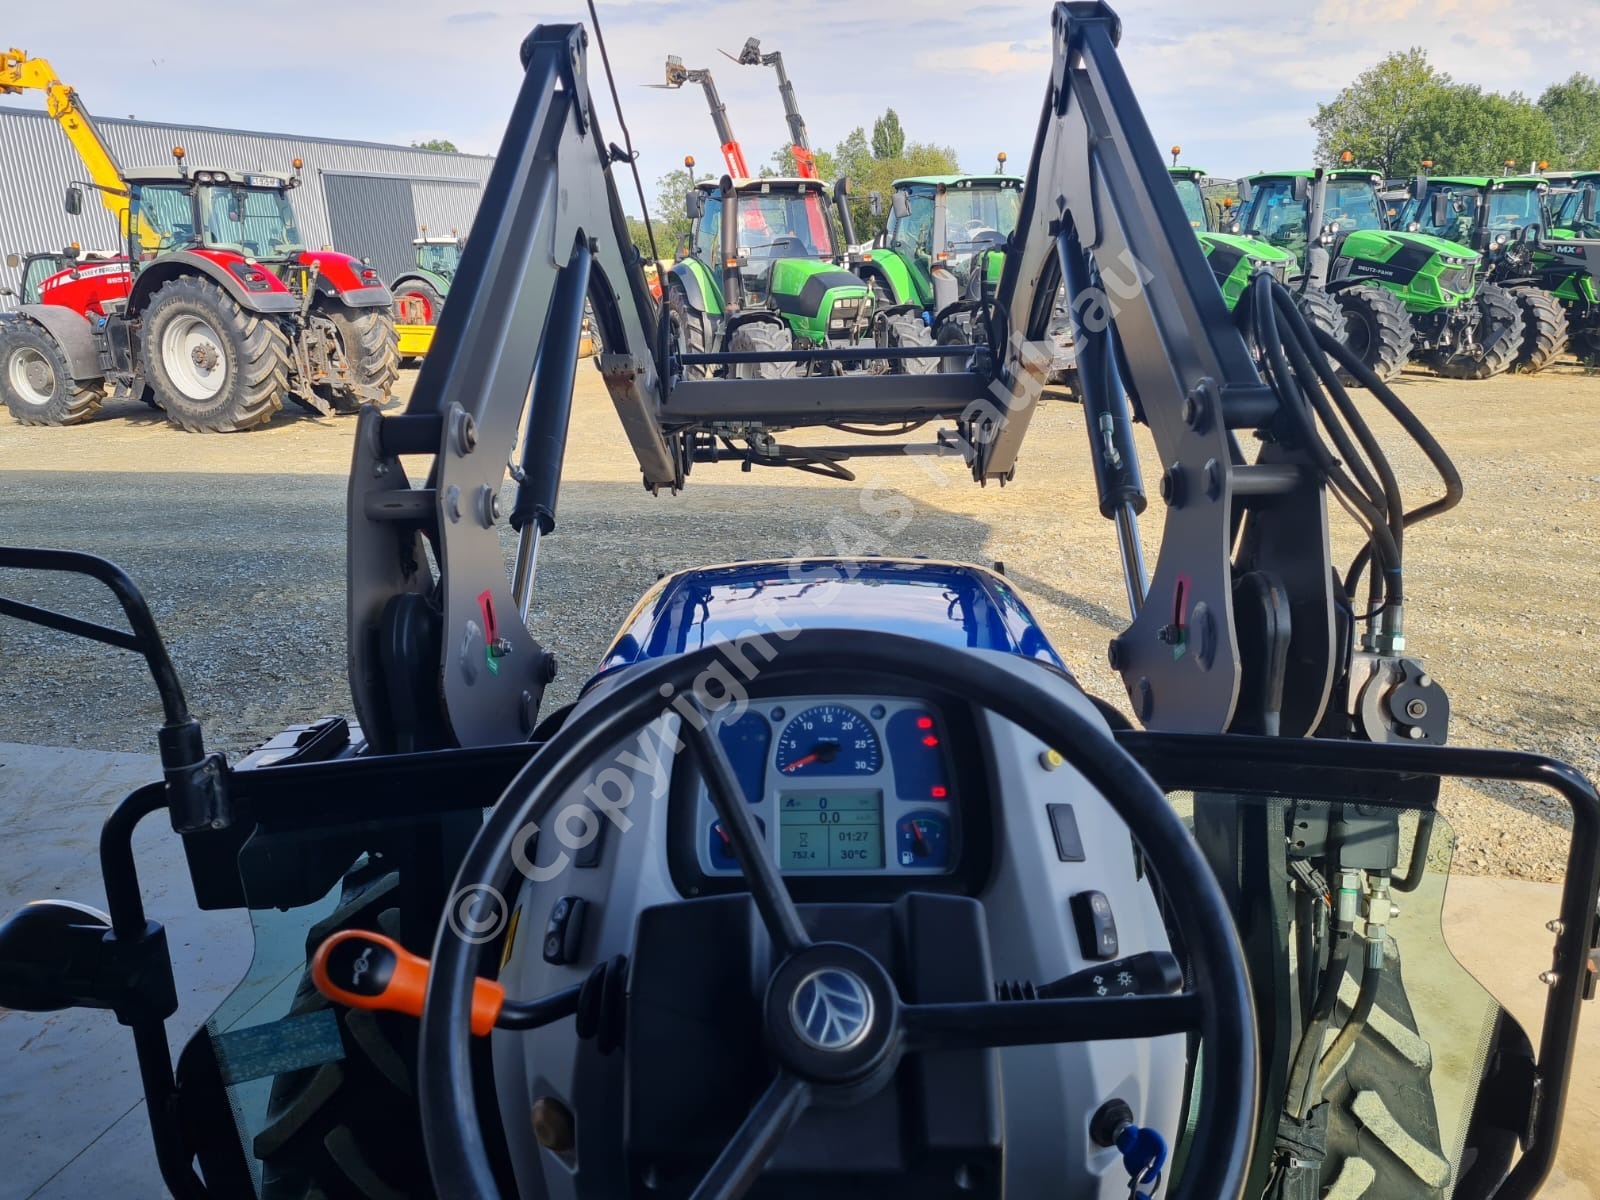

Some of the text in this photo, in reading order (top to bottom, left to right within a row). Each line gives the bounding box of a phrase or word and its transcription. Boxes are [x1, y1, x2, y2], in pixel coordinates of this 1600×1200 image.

[1358, 265, 1394, 277] DEUTZ-FAHR
[822, 714, 833, 723] 15
[803, 722, 813, 730] 10
[841, 721, 853, 730] 20
[790, 740, 796, 749] 5
[855, 740, 866, 749] 25
[855, 761, 866, 769] 30
[819, 797, 828, 809] 0
[819, 811, 840, 824] 0.0
[838, 831, 869, 841] 01:27
